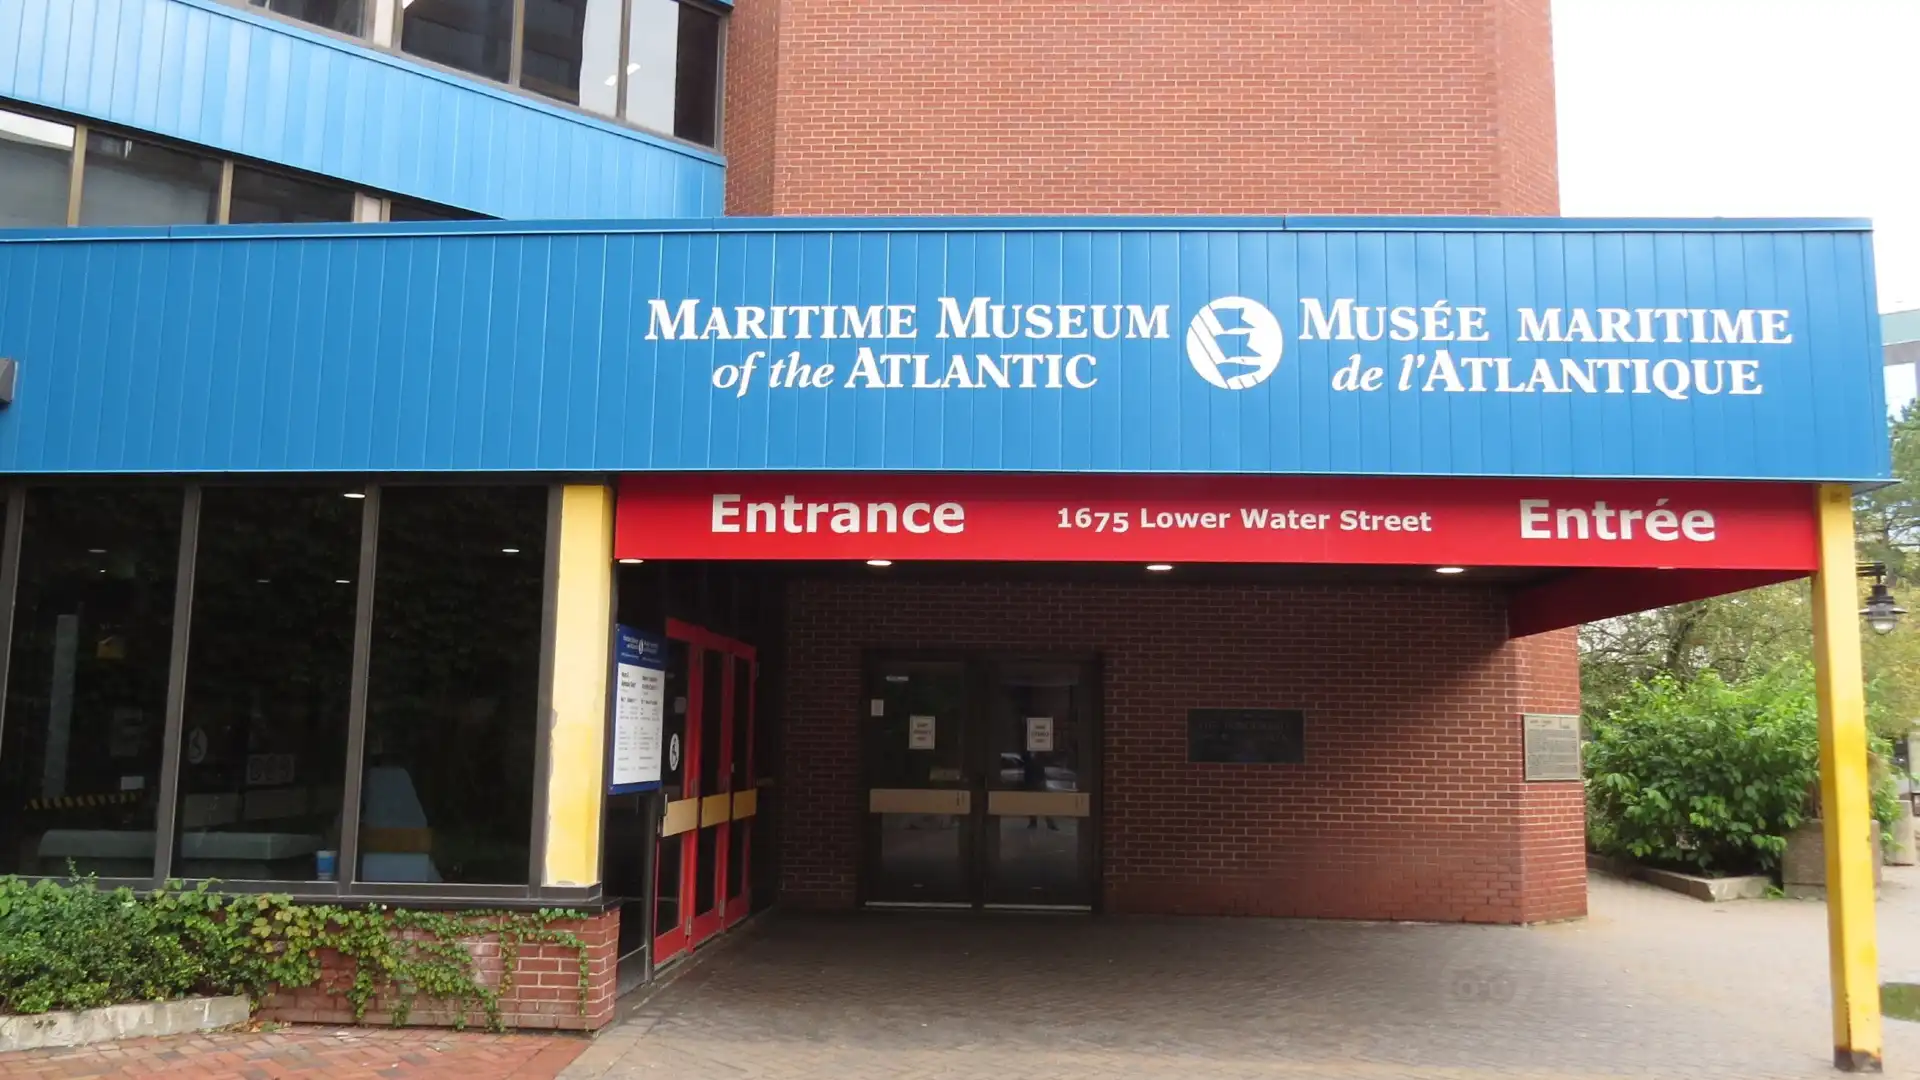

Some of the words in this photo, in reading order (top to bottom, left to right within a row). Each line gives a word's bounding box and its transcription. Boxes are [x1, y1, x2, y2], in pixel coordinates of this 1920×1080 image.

[645, 298, 918, 340] MARITIME
[936, 296, 1170, 339] MUSEUM
[1299, 297, 1490, 341] MUSÉE
[1517, 307, 1793, 344] MARITIME
[712, 351, 765, 397] of
[769, 351, 835, 388] the
[844, 347, 1097, 388] ATLANTIC
[1332, 353, 1383, 391] de
[711, 494, 965, 534] Entrance
[1058, 508, 1129, 533] 1675
[1141, 508, 1230, 528] Lower
[1241, 509, 1330, 529] Water
[1340, 510, 1432, 532] Street
[1520, 498, 1716, 541] Entrée
